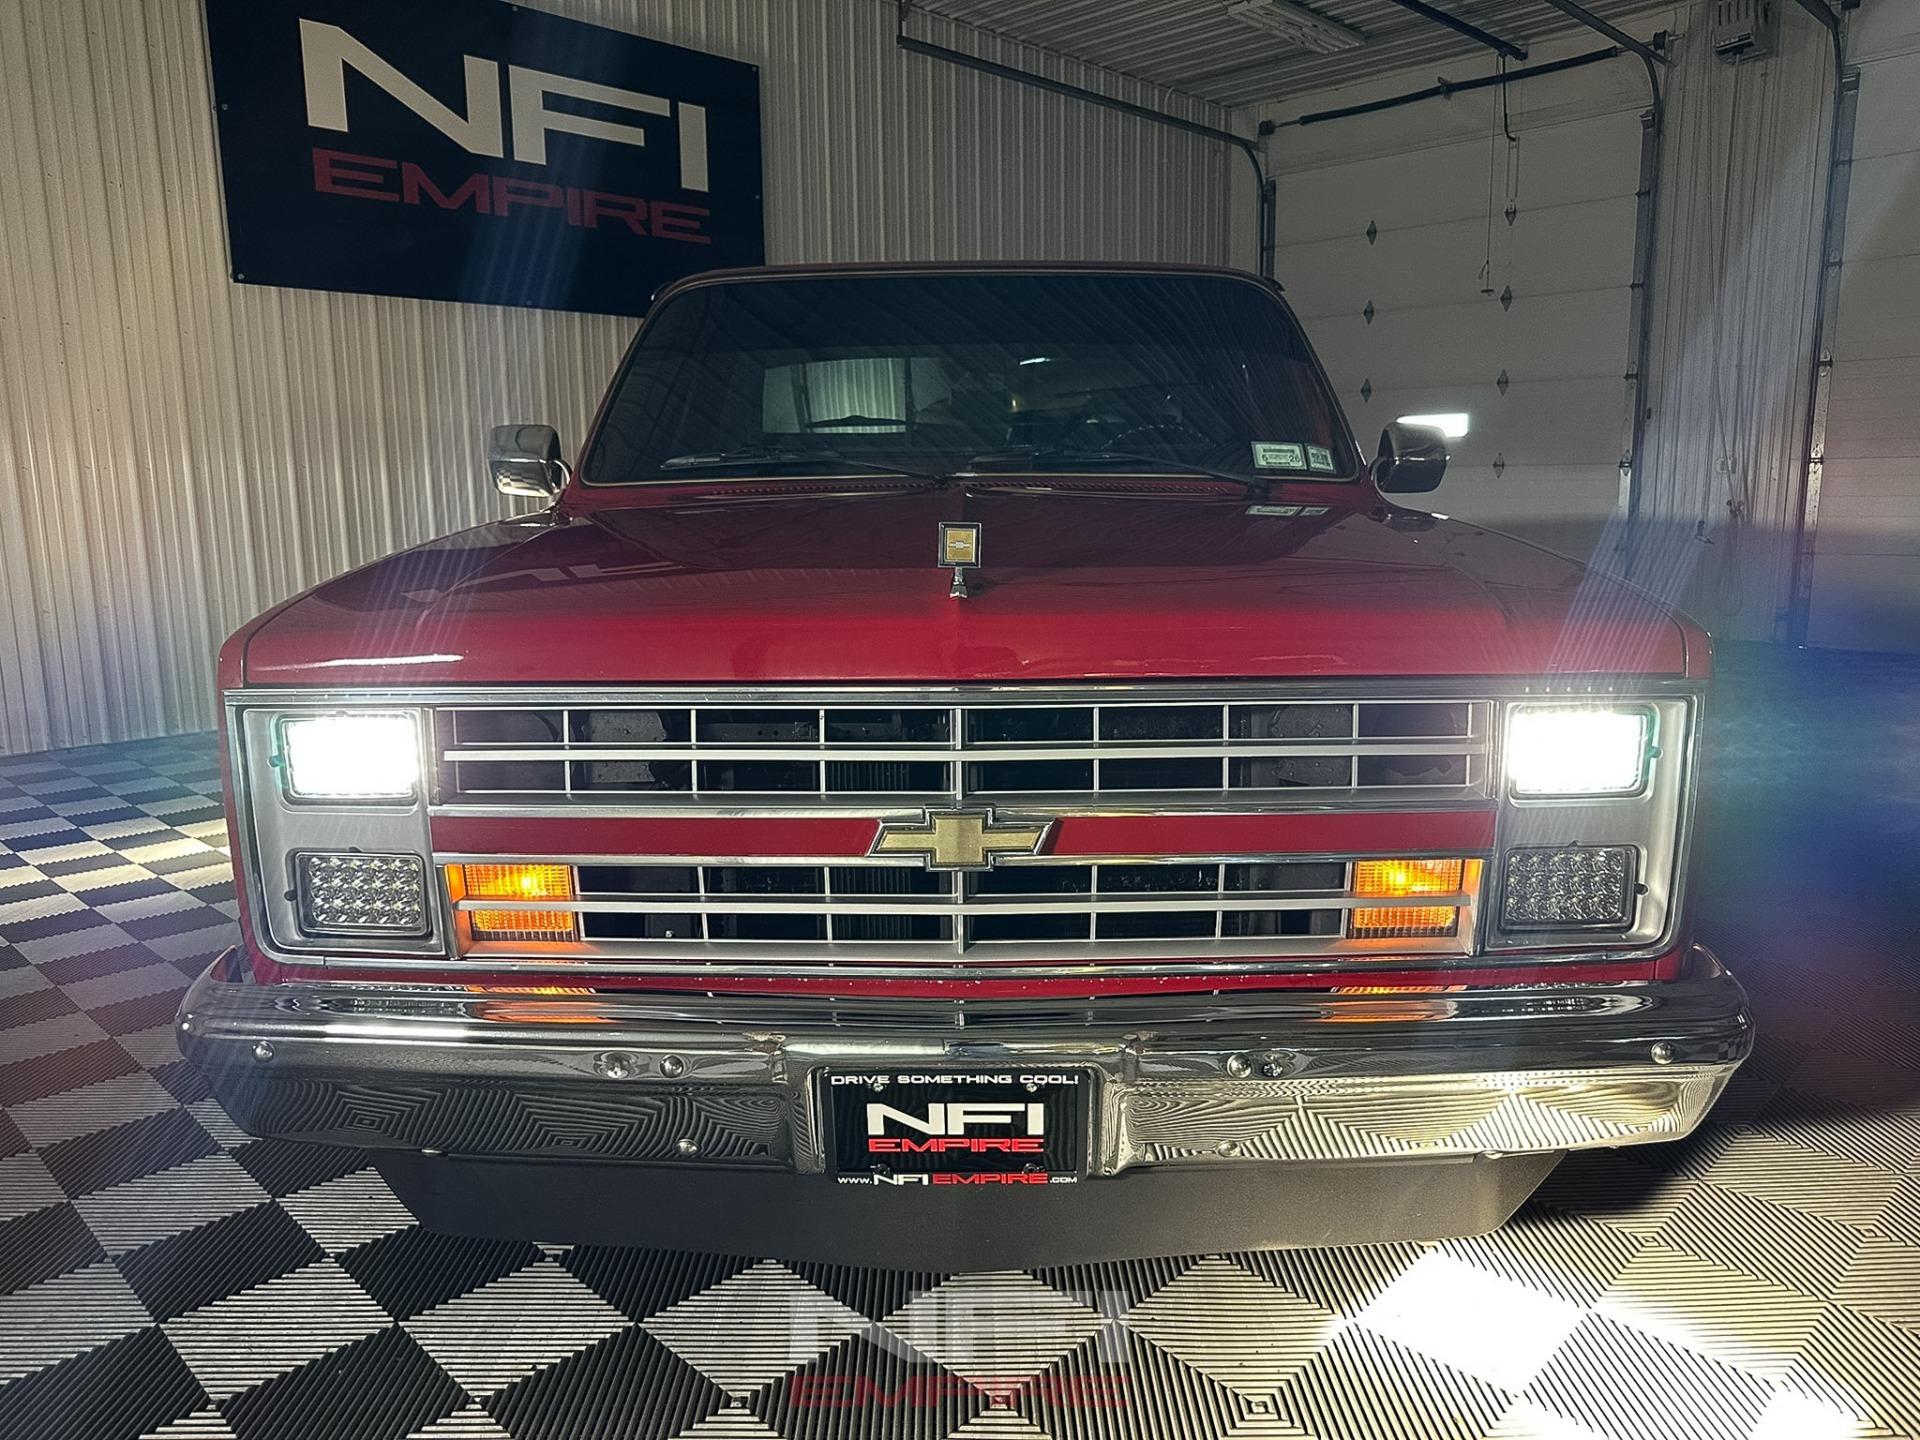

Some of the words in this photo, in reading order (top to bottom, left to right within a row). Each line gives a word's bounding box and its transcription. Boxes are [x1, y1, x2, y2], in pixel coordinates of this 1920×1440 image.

[298, 17, 709, 192] NFI
[311, 147, 712, 244] EMPIRE
[831, 1075, 891, 1085] DRIVE
[897, 1075, 1013, 1085] SOMETHING
[1019, 1075, 1079, 1085] COOL!
[866, 1103, 1045, 1136] NFI
[868, 1138, 1045, 1153] EMPIRE
